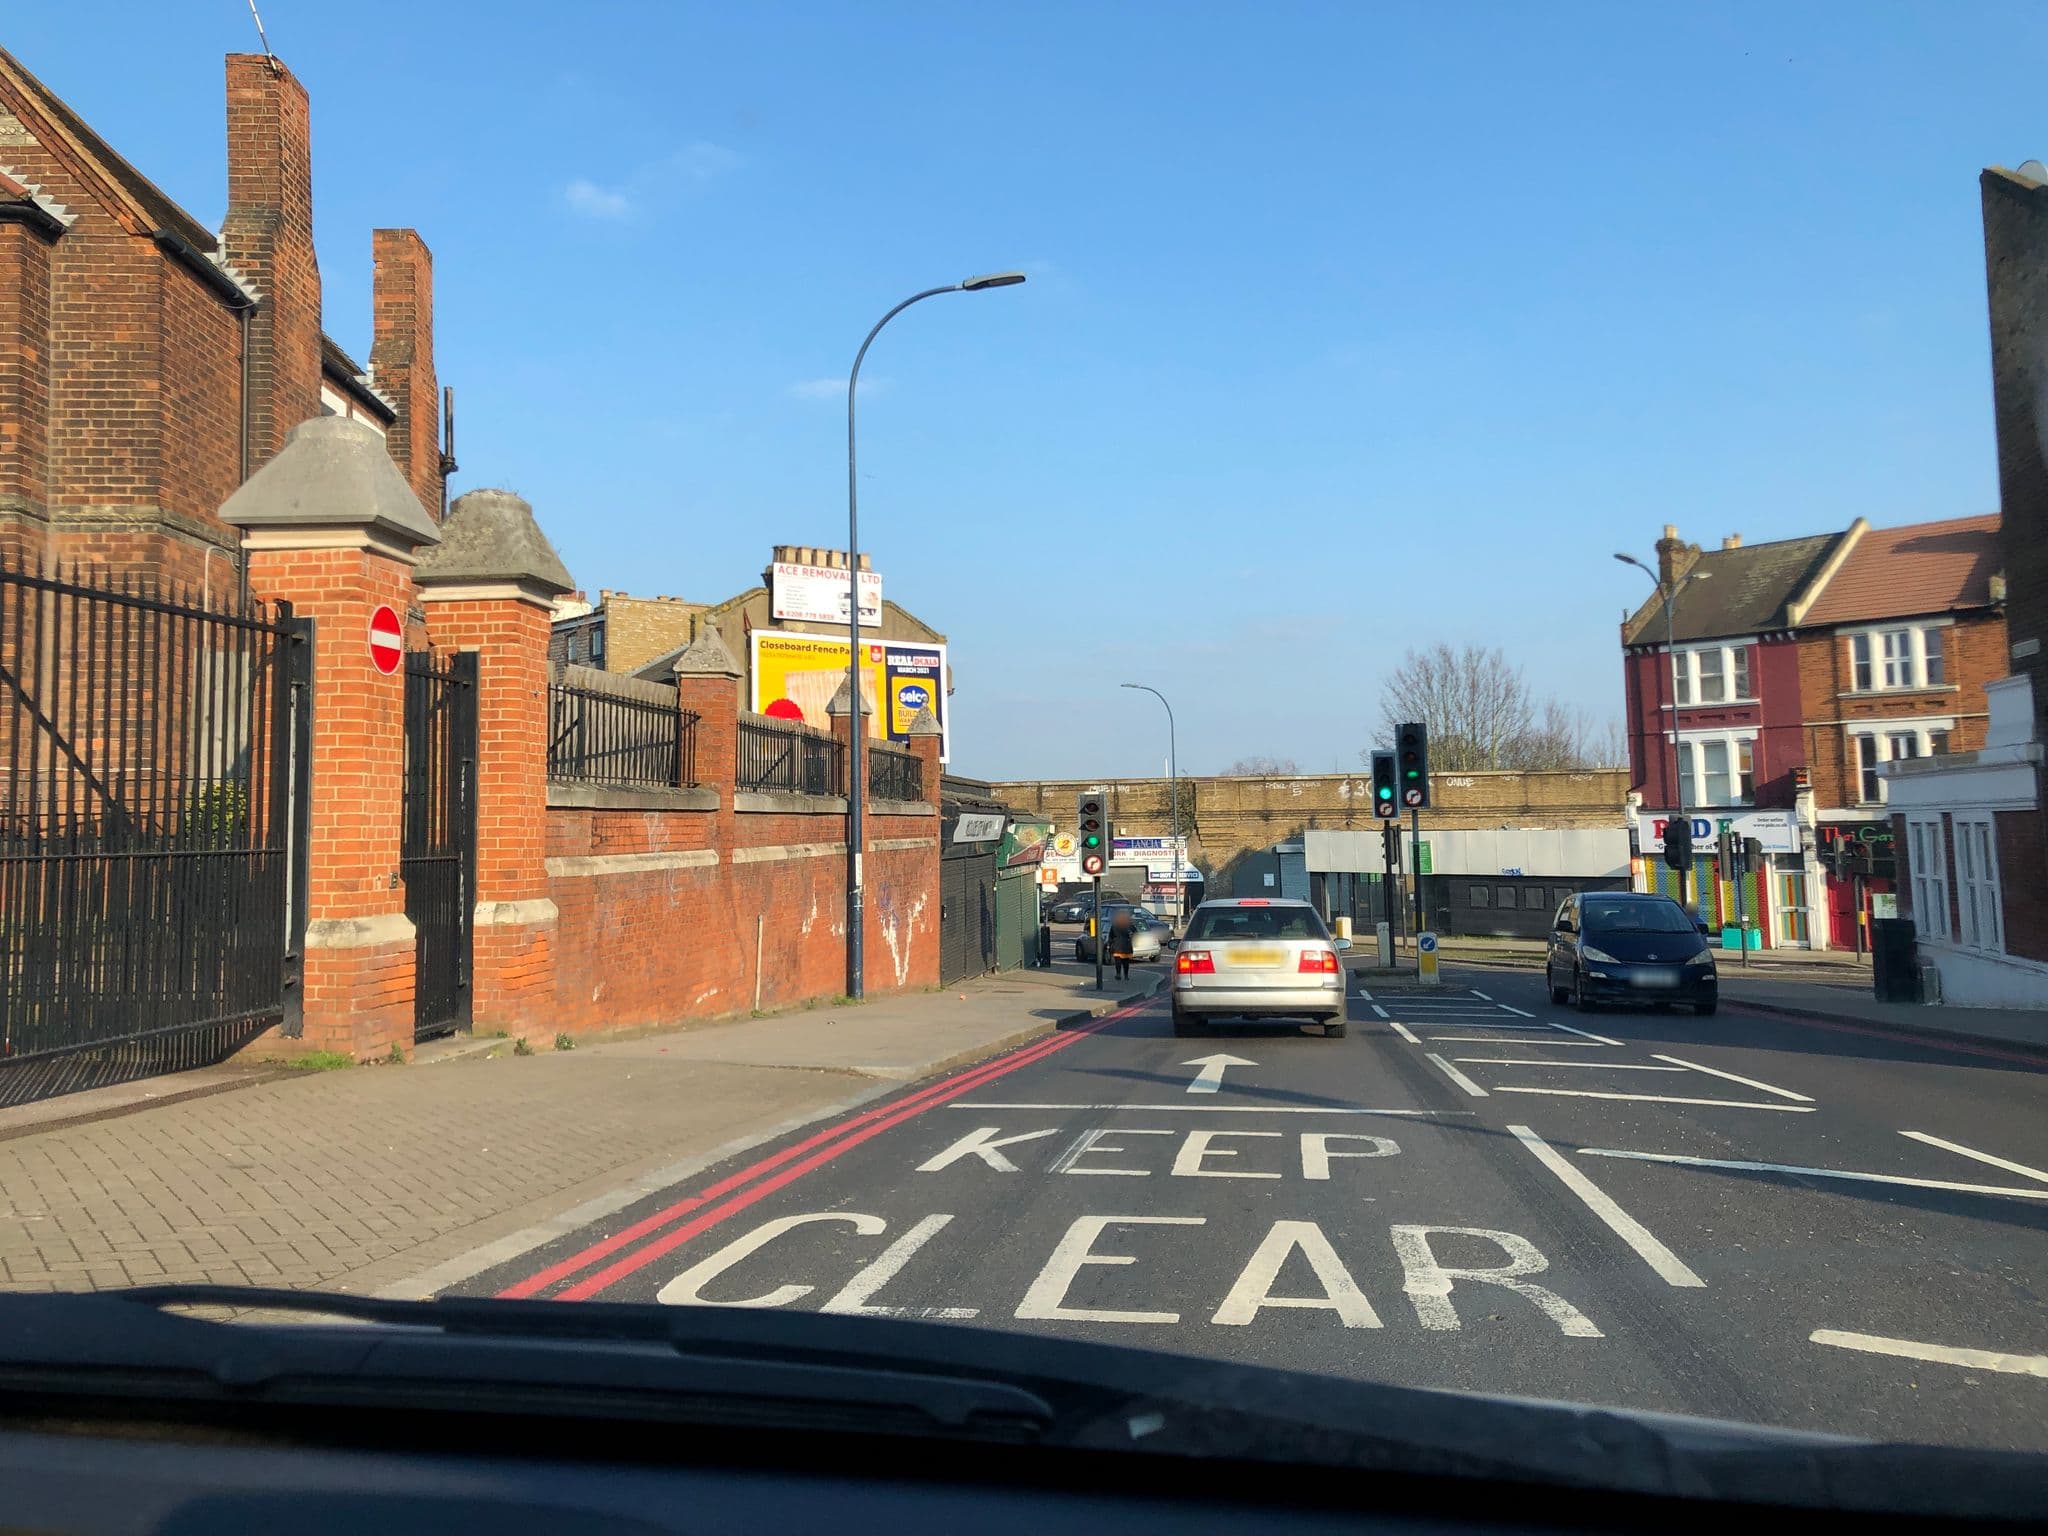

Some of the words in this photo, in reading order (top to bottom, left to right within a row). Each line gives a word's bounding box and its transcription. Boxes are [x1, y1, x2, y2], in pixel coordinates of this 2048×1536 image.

[778, 565, 798, 576] ACE
[802, 567, 854, 582] REMOVAL
[861, 575, 880, 585] LTD
[760, 641, 811, 652] Closeboard
[813, 644, 838, 654] Fence
[840, 647, 863, 657] Pal
[914, 657, 938, 667] DEALS
[1652, 818, 1734, 839] PDE
[1860, 827, 1895, 842] Gar
[1060, 839, 1069, 848] 2
[1131, 839, 1161, 848] LANCIA
[1134, 849, 1185, 858] DIAGNOSTIS
[915, 1127, 1402, 1181] KEEP
[656, 1212, 1604, 1338] CLEAR
